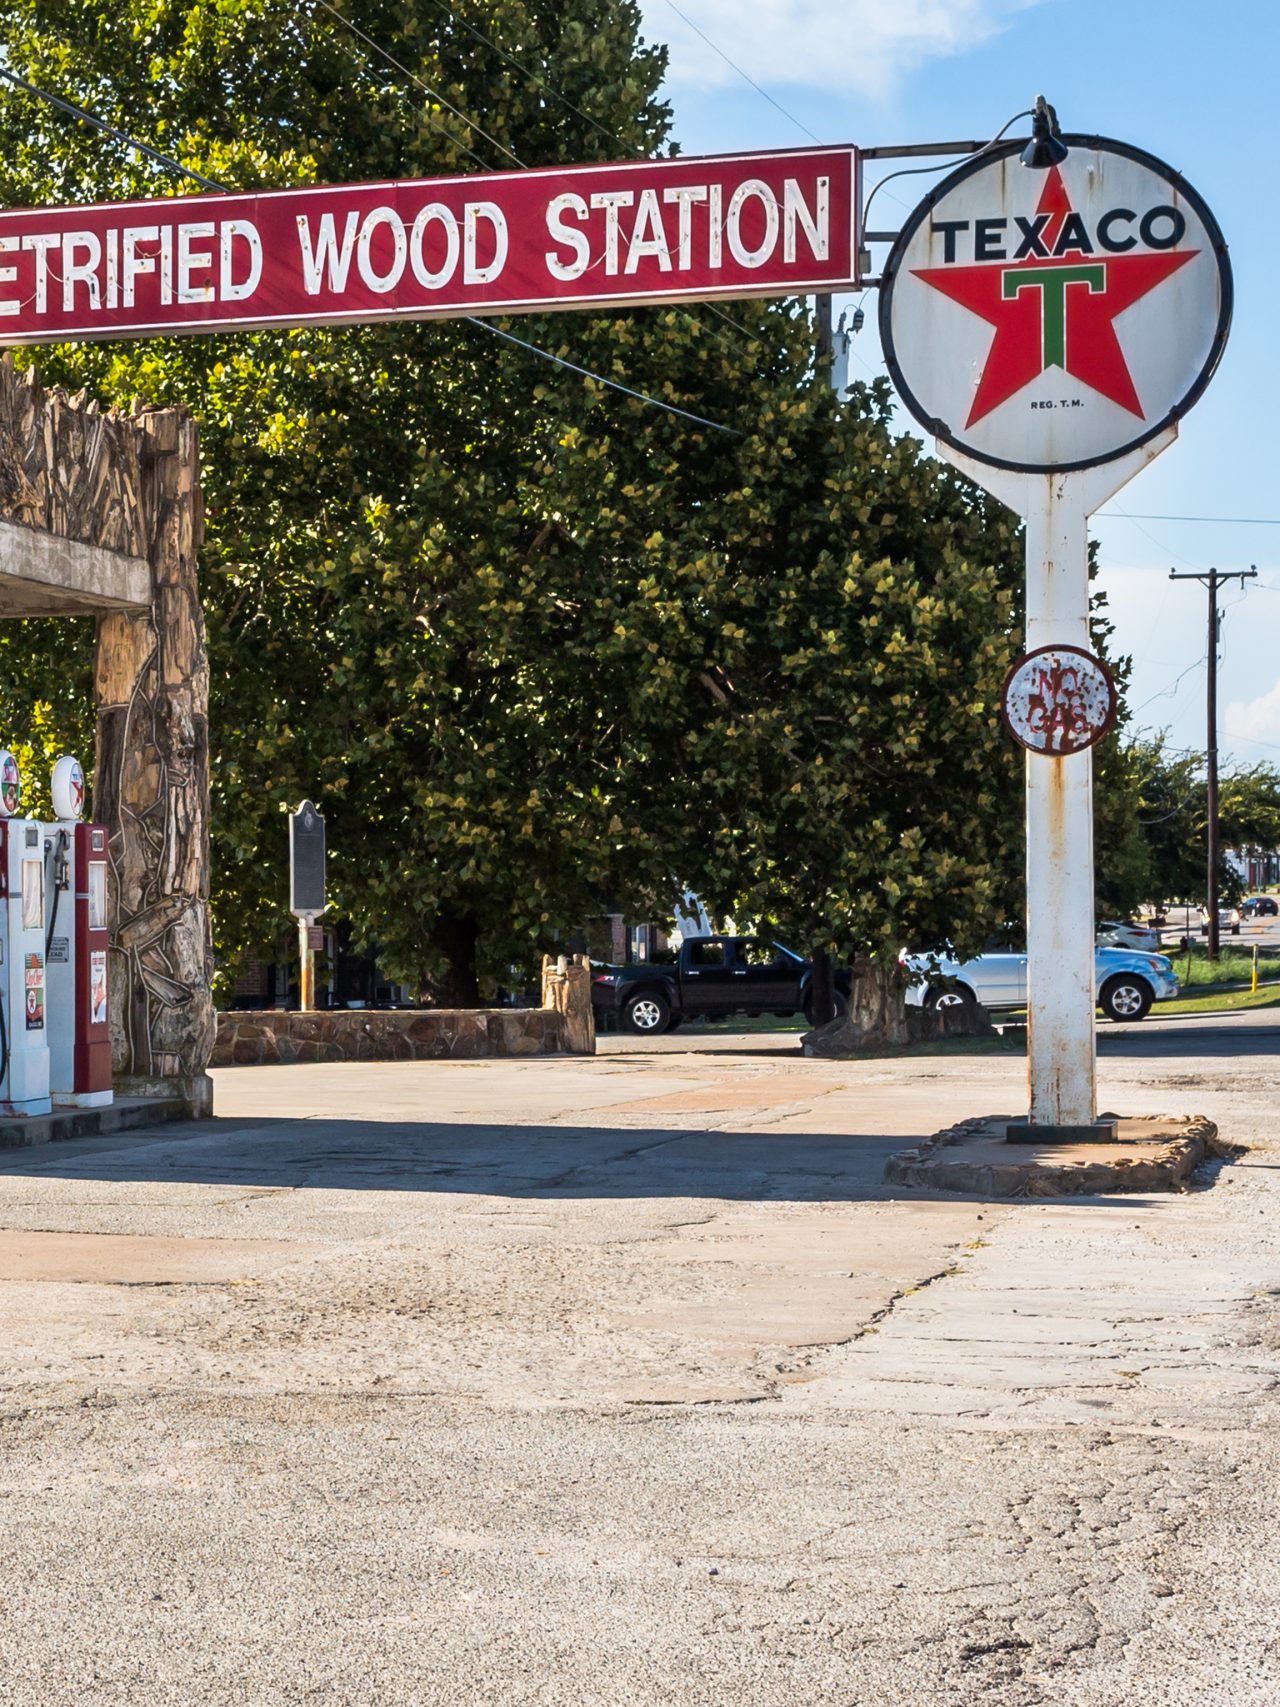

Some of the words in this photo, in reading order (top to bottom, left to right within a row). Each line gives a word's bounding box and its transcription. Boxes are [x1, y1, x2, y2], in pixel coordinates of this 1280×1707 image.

[296, 201, 508, 295] WOOD
[545, 176, 829, 281] STATION
[931, 205, 1186, 263] TEXACO
[1002, 264, 1106, 372] T
[1031, 400, 1057, 409] REG.
[1060, 399, 1085, 408] T.M.
